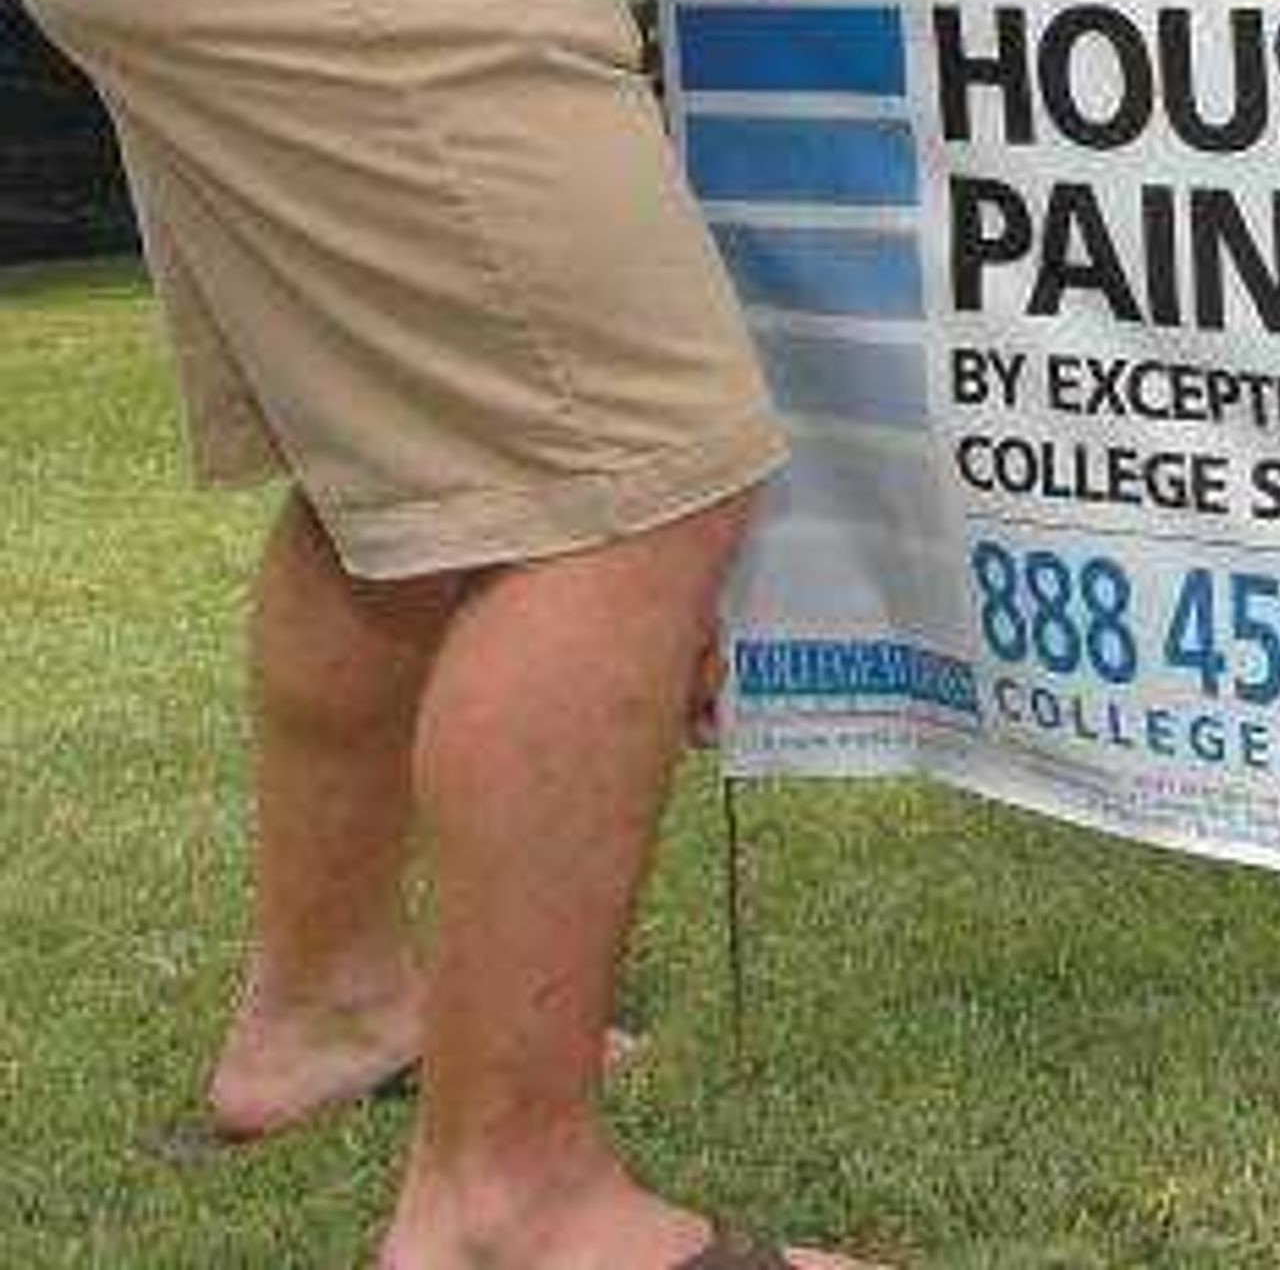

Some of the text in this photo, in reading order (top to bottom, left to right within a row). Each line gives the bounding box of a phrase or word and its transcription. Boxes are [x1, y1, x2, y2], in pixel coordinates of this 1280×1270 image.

[952, 347, 1028, 406] BY
[956, 435, 1229, 514] COLLEGE
[971, 541, 1138, 685] 888
